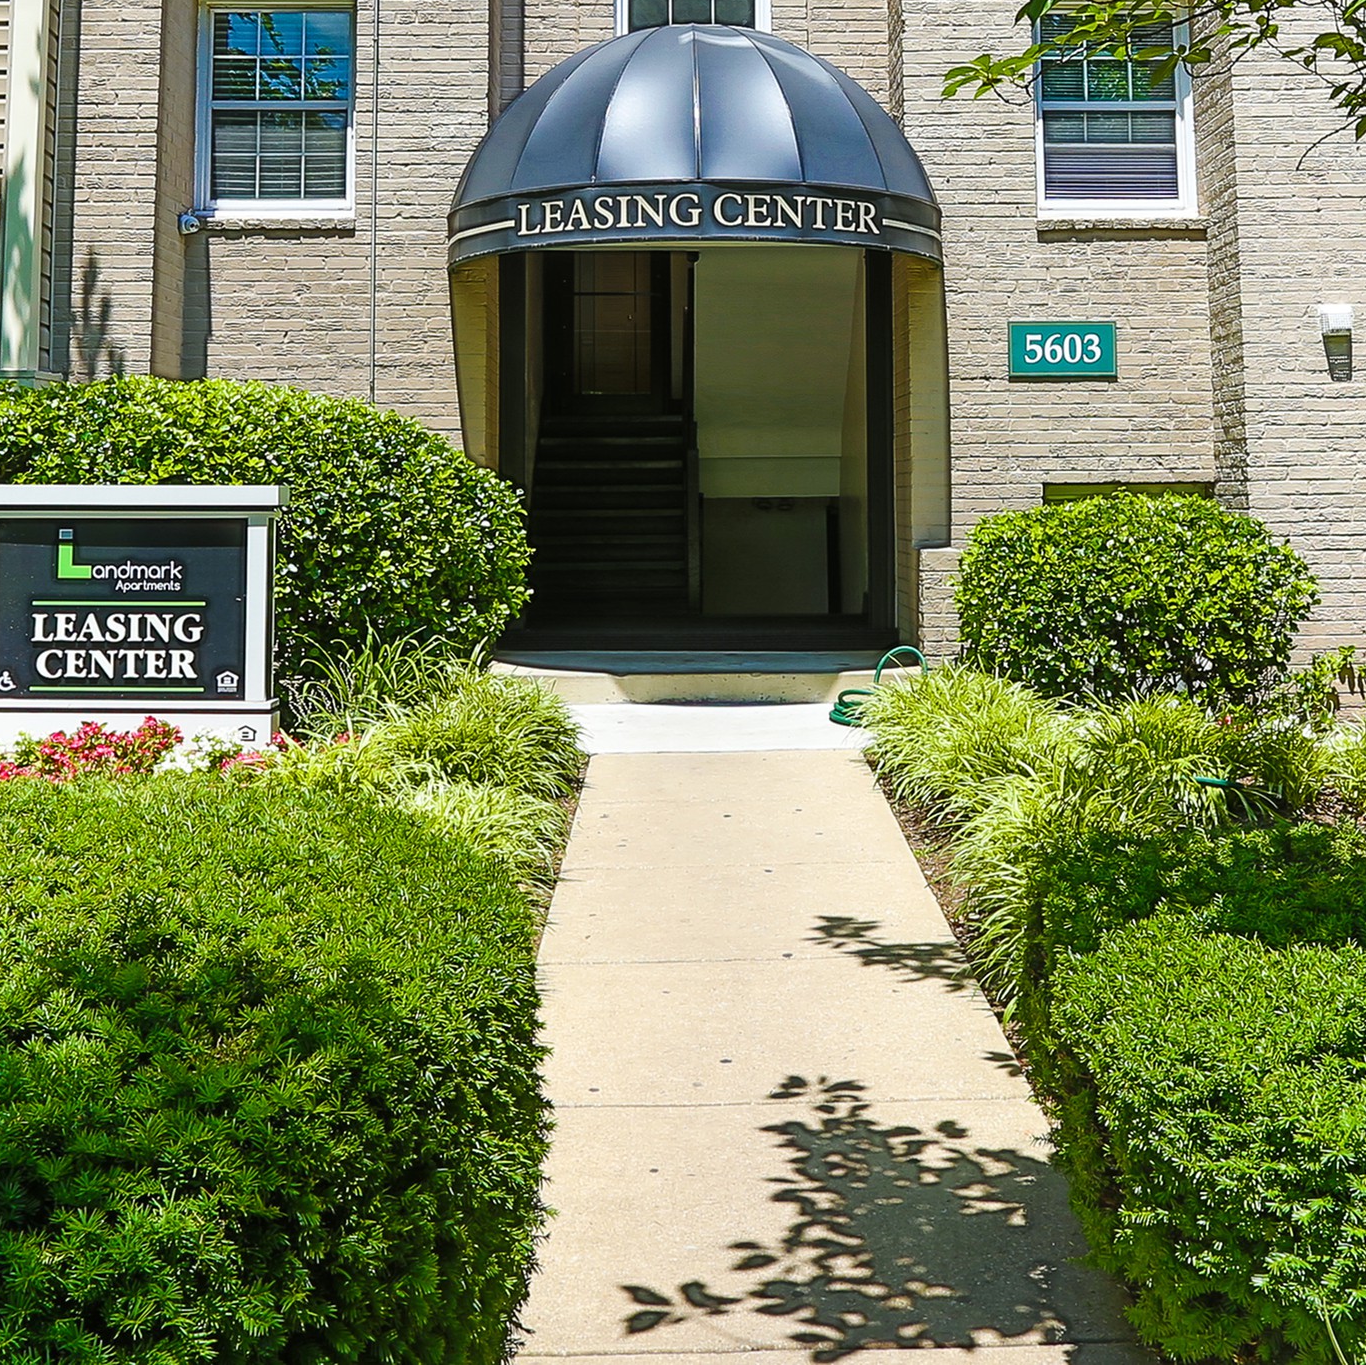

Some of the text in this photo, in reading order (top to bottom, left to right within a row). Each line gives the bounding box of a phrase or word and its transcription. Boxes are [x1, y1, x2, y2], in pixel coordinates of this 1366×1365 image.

[516, 192, 881, 236] LEASING CENTER
[1023, 333, 1102, 364] 5603
[57, 542, 182, 579] Landmark
[115, 579, 181, 593] Apartments
[31, 613, 204, 643] LEASING
[35, 649, 198, 679] CENTER
